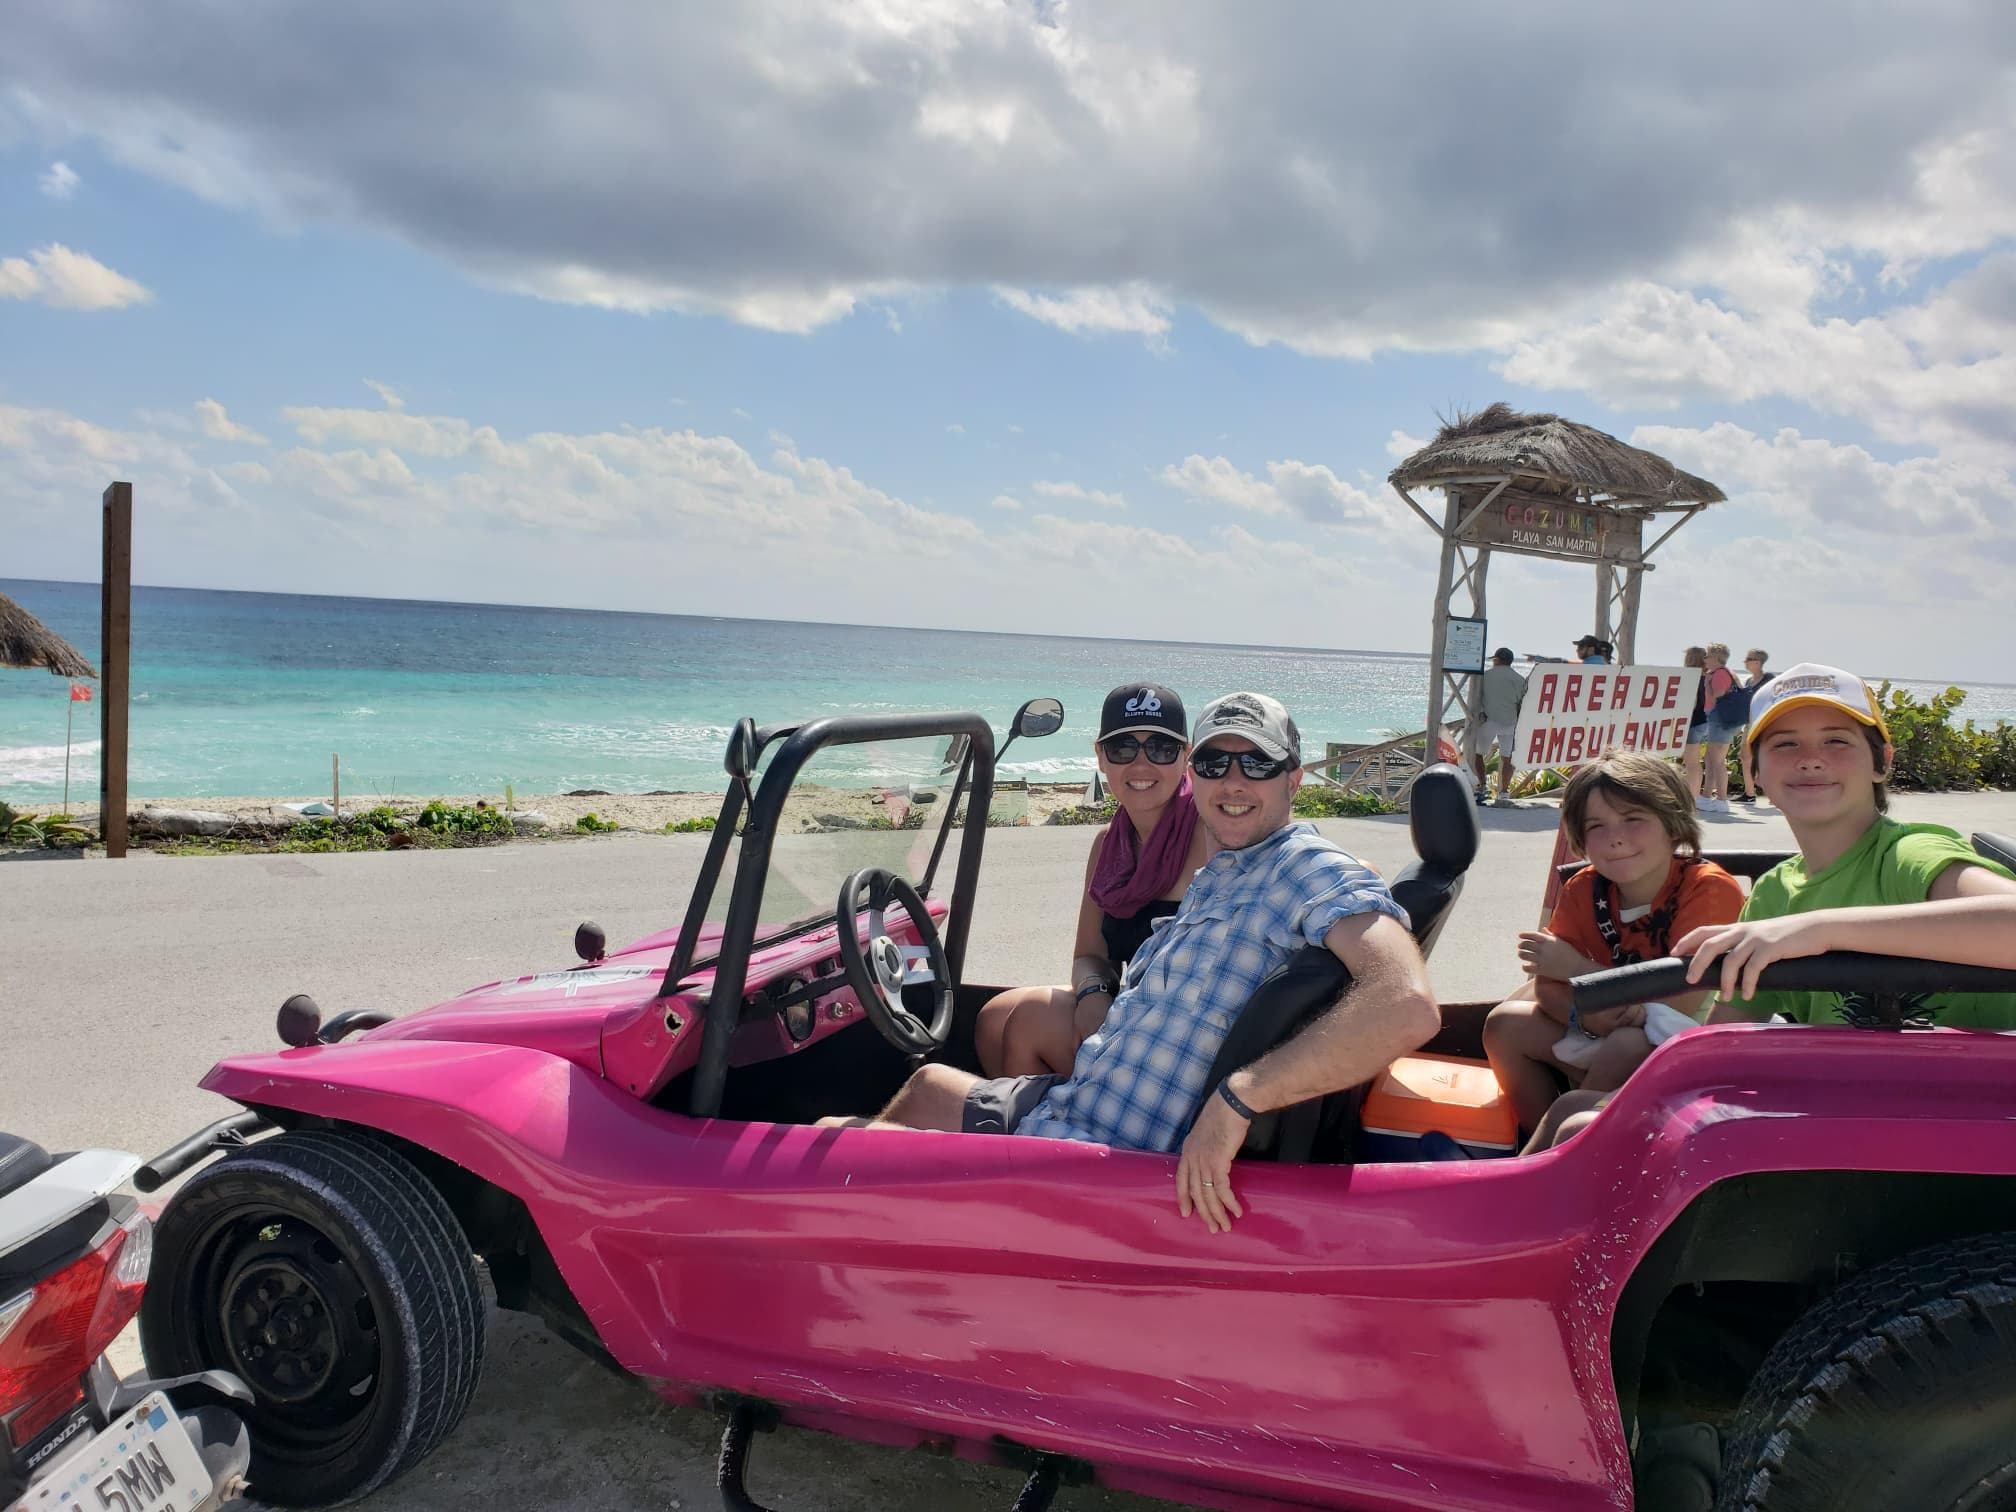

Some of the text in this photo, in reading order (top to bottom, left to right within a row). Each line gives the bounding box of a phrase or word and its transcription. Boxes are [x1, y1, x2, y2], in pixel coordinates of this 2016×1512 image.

[1512, 529, 1540, 545] PLAYA
[1545, 535, 1564, 549] SAN
[1537, 673, 1681, 713] AREA DE
[27, 1414, 89, 1470] HONDA
